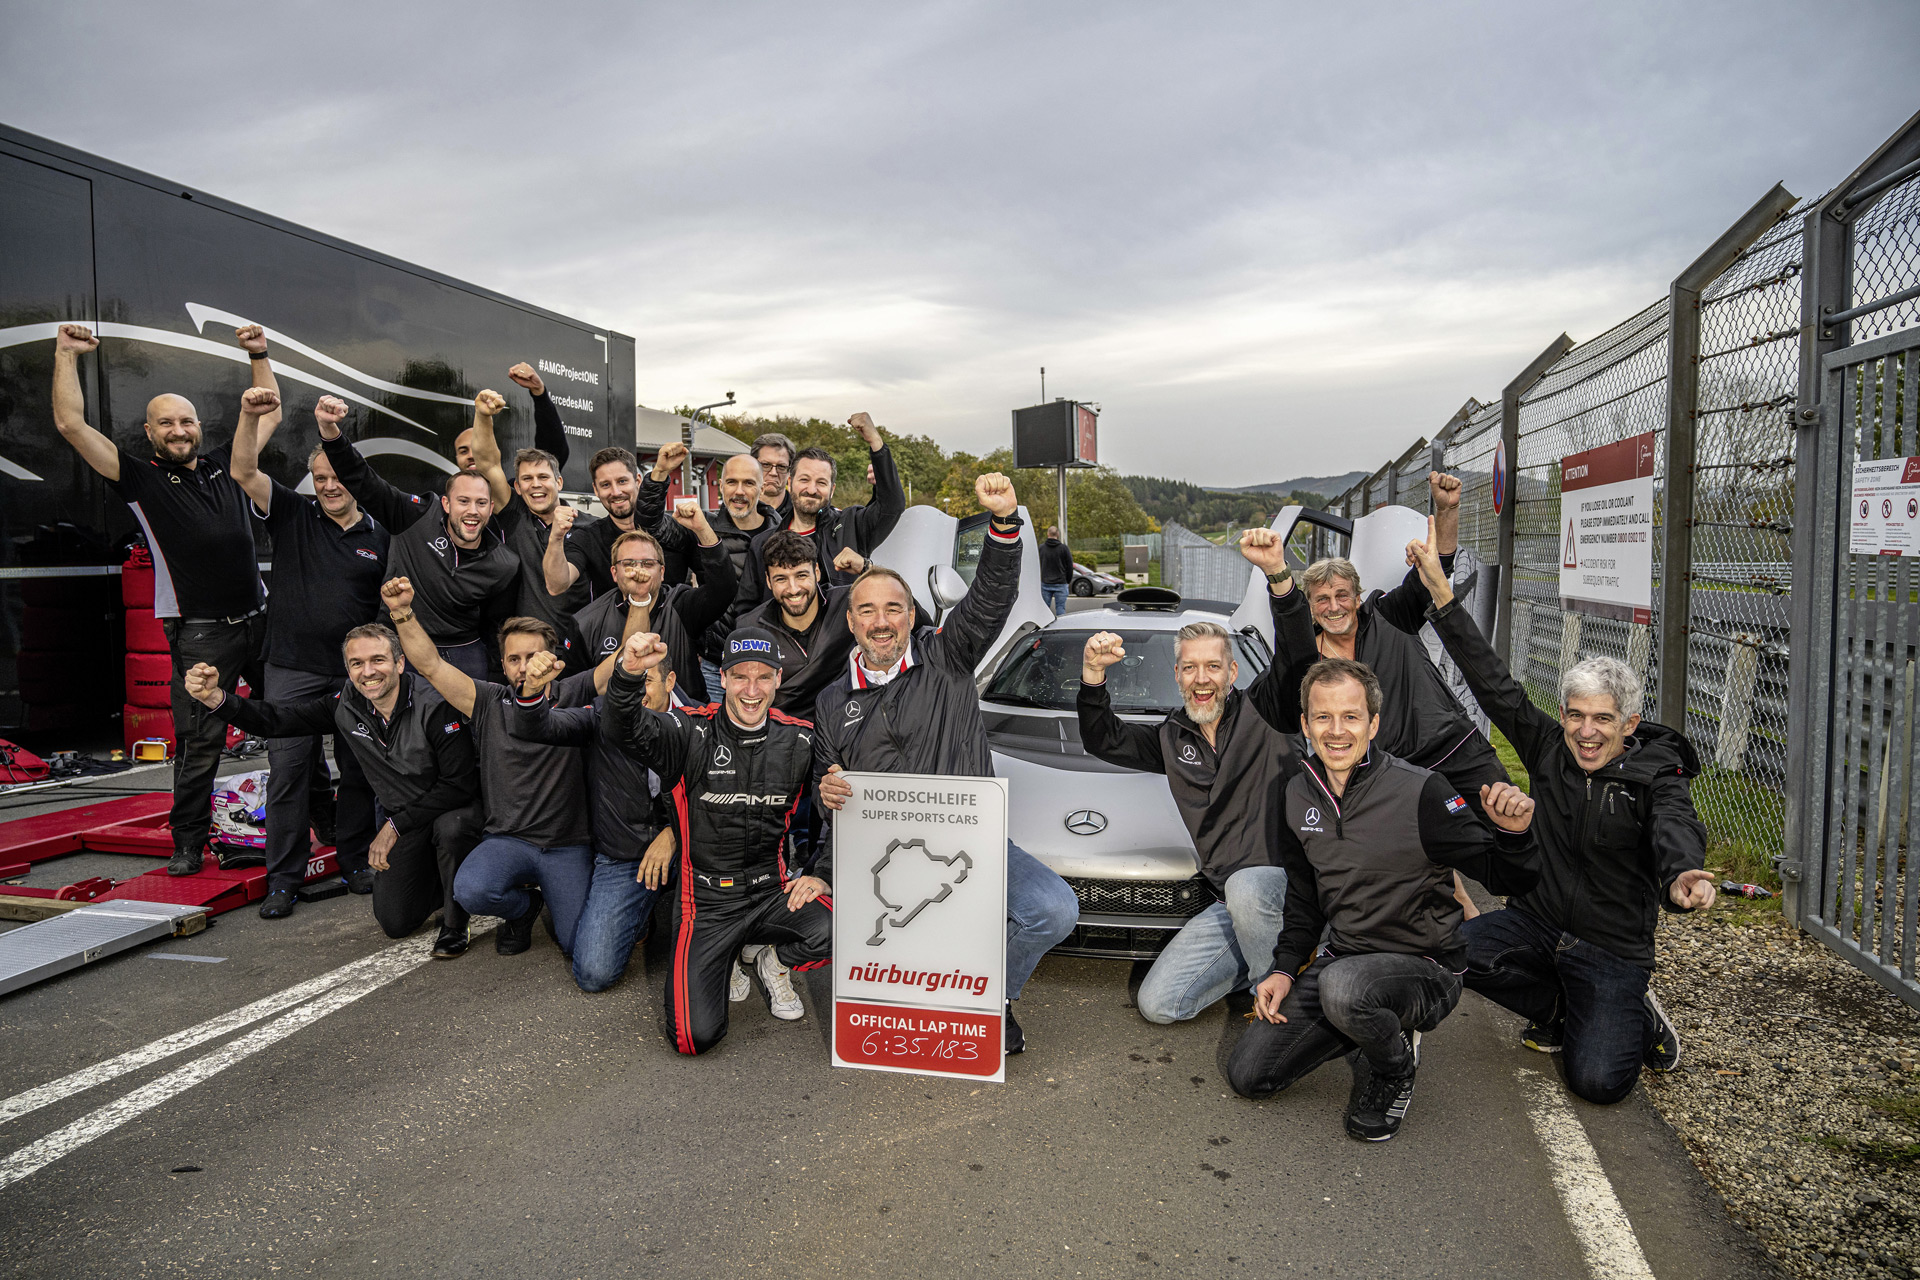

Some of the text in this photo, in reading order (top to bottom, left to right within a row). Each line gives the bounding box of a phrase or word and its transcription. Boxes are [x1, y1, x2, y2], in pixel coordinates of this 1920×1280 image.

[539, 359, 599, 385] #AMGProjectONE
[561, 421, 593, 438] ormance
[1565, 464, 1589, 481] ATTENTION
[1581, 502, 1585, 512] IF
[1592, 500, 1601, 510] LOSE
[1608, 498, 1614, 508] OR
[1614, 496, 1634, 508] COOLANT
[1580, 512, 1650, 528] PLEASE STOP IMMEDIATELY AND CALL
[1580, 534, 1600, 544] EMERGENCY
[1601, 533, 1617, 543] NUMBER
[1583, 559, 1616, 569] ACCIDENT RISK FOR
[1604, 576, 1620, 588] TRAFFIC
[741, 639, 771, 653] BWT
[863, 788, 977, 806] NORDSCHLEIFE
[862, 809, 979, 825] SUPER SPORTS CARS
[304, 859, 325, 877] KG
[849, 962, 989, 996] nürburgring
[849, 1013, 987, 1038] OFFICIAL LAP TIME
